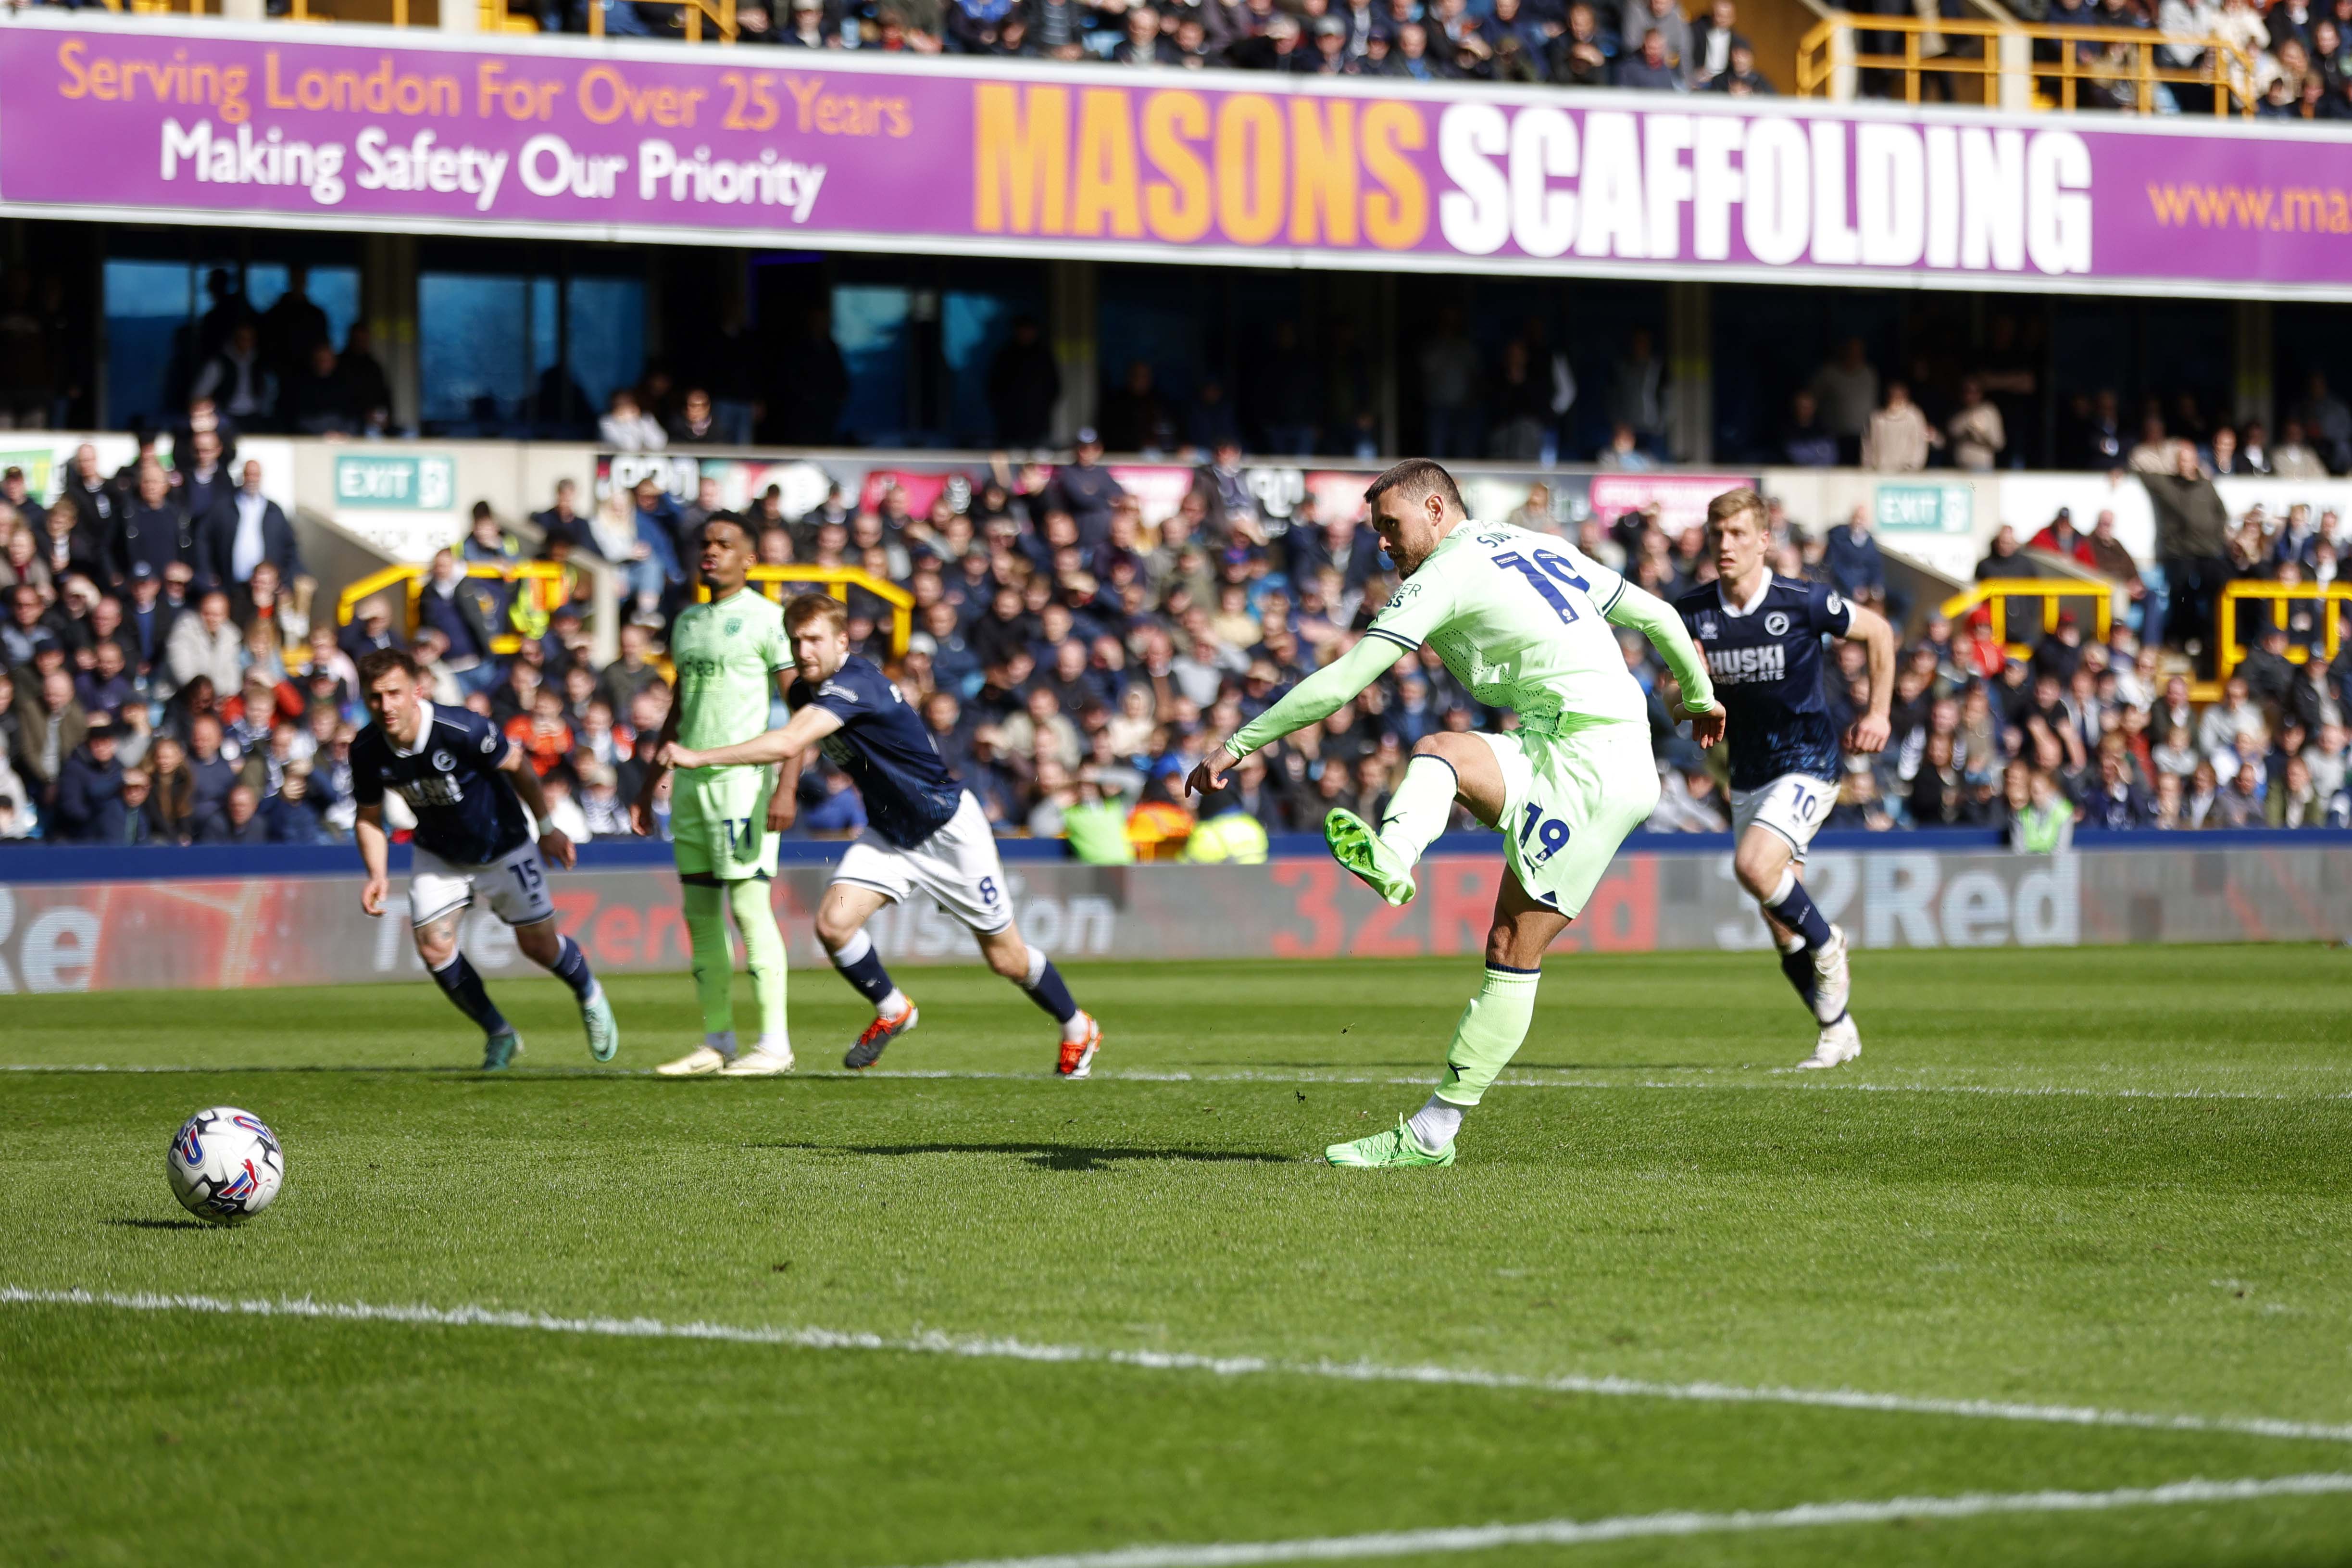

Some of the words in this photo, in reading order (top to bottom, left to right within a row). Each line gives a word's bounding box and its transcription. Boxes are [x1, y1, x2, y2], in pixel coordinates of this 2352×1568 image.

[58, 38, 250, 124] Serving
[265, 50, 461, 117] London
[477, 59, 564, 121] For
[577, 64, 708, 128] Over
[719, 71, 780, 132] 25
[784, 75, 913, 138] Years
[161, 117, 347, 205] Making
[355, 125, 509, 212] Safety
[518, 133, 628, 199] Our
[638, 138, 826, 224] Priority
[974, 81, 1429, 251] MASONS
[1439, 101, 2092, 276] SCAFFOLDING
[2147, 182, 2352, 234] www.ma
[339, 463, 413, 498] EXIT
[1880, 491, 1937, 524] EXIT
[1707, 643, 1785, 675] HUSKI
[1792, 783, 1816, 821] 10
[722, 818, 751, 849] 11
[1519, 802, 1570, 862] 19
[508, 858, 541, 893] 15
[980, 876, 998, 904] 8
